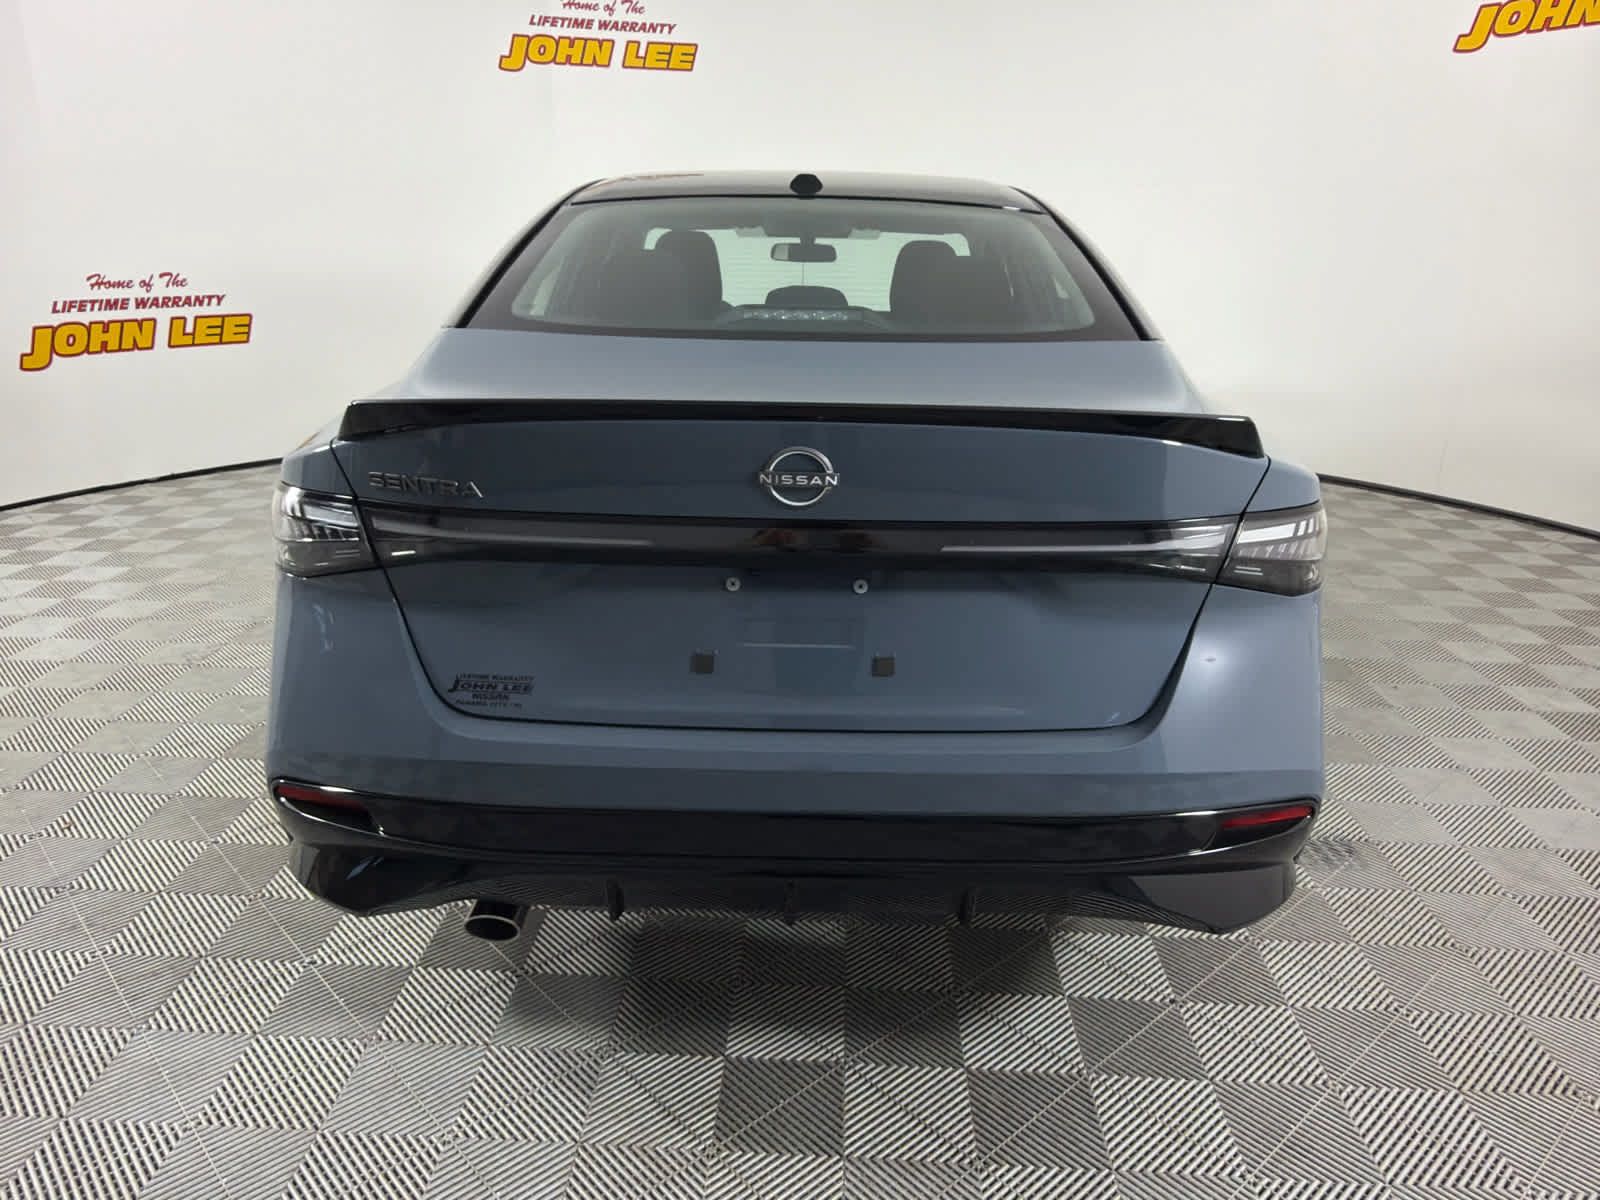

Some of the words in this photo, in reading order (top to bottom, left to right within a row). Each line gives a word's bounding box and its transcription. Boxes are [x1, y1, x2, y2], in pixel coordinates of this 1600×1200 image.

[560, 0, 600, 11] Home
[603, 1, 616, 16] of
[621, 0, 645, 14] The
[529, 14, 595, 30] LIFETIME
[598, 19, 677, 35] WARRANTY
[499, 34, 615, 72] JOHN
[622, 40, 698, 71] LEE
[86, 274, 134, 290] Home
[139, 275, 154, 293] of
[159, 272, 188, 288] The
[51, 298, 129, 314] LIFETIME
[134, 294, 225, 310] WARRANTY
[20, 318, 156, 371] JOHN
[168, 313, 252, 348] LEE
[368, 471, 483, 498] SENTRA
[759, 474, 838, 486] NISSAN
[448, 673, 498, 692] JOHN
[503, 681, 535, 695] LEE
